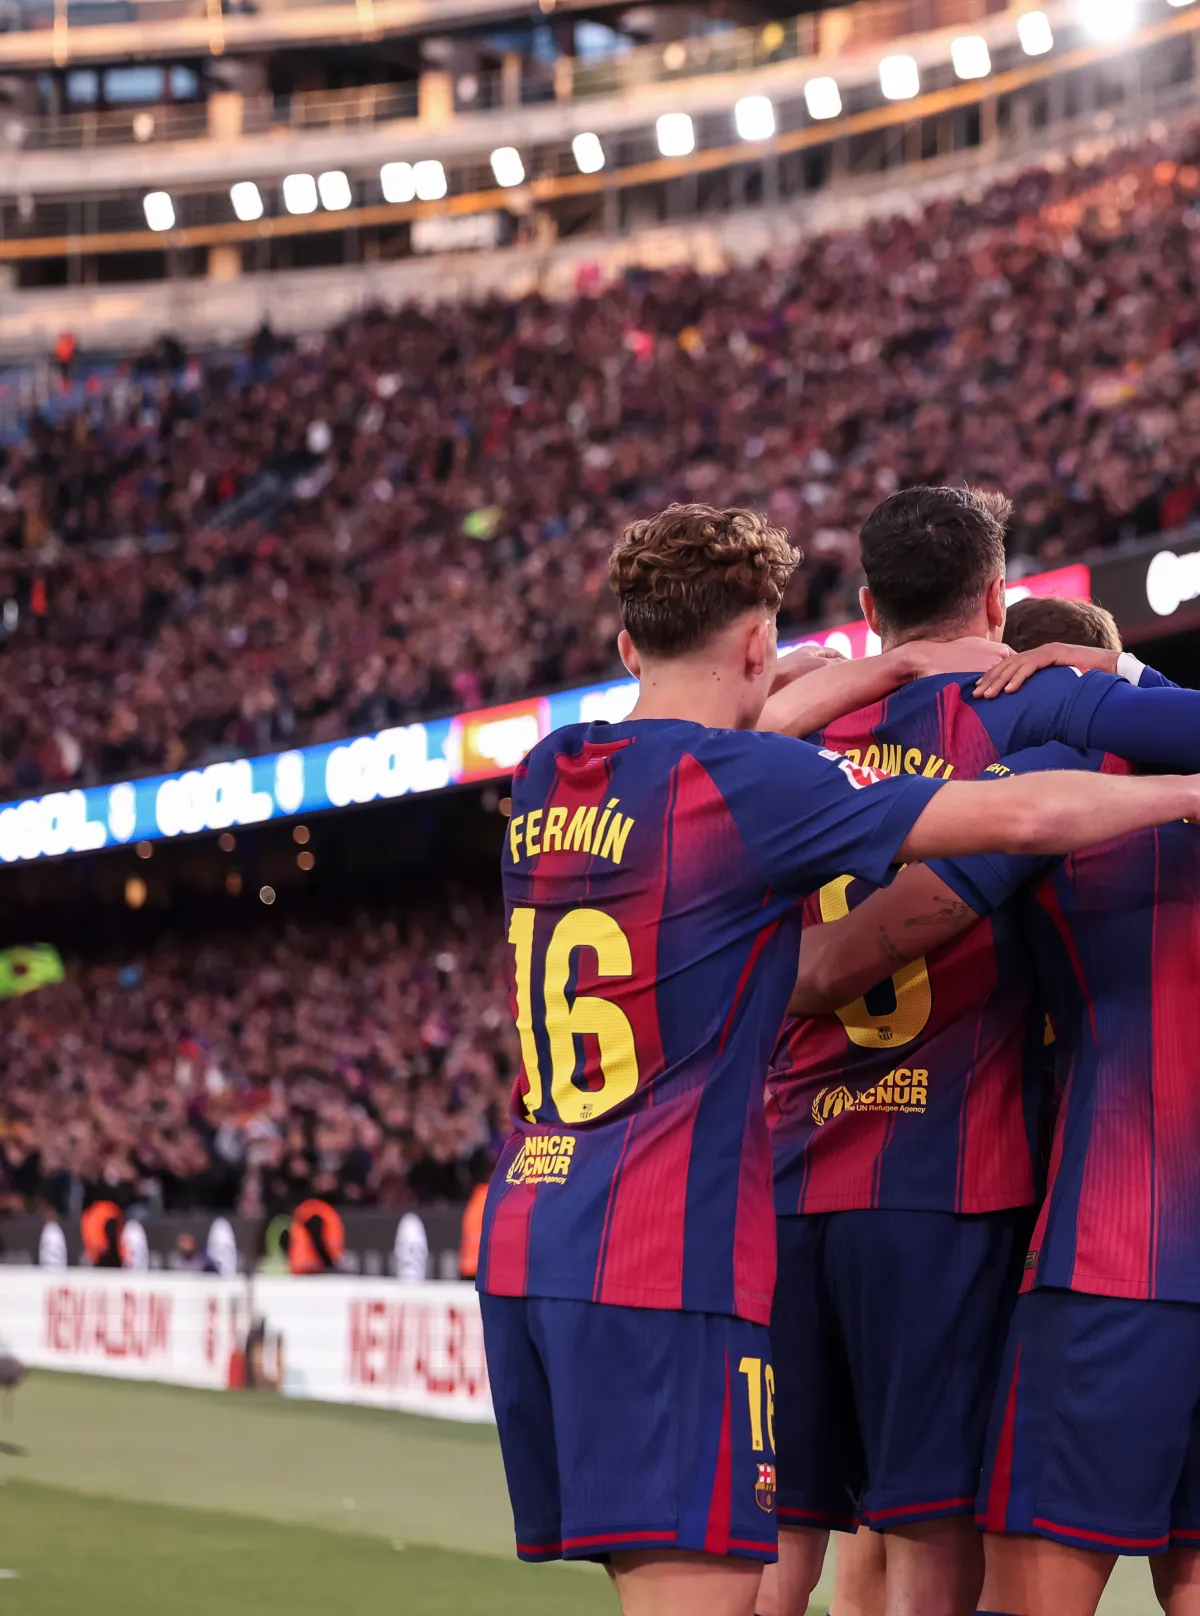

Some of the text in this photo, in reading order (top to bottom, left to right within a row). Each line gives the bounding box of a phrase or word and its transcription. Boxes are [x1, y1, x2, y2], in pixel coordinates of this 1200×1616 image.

[510, 797, 635, 865] FERMÍN
[507, 907, 639, 1124] 16
[900, 1105, 926, 1113] Agency
[525, 1135, 576, 1156] NHCR
[524, 1155, 571, 1176] CNUR
